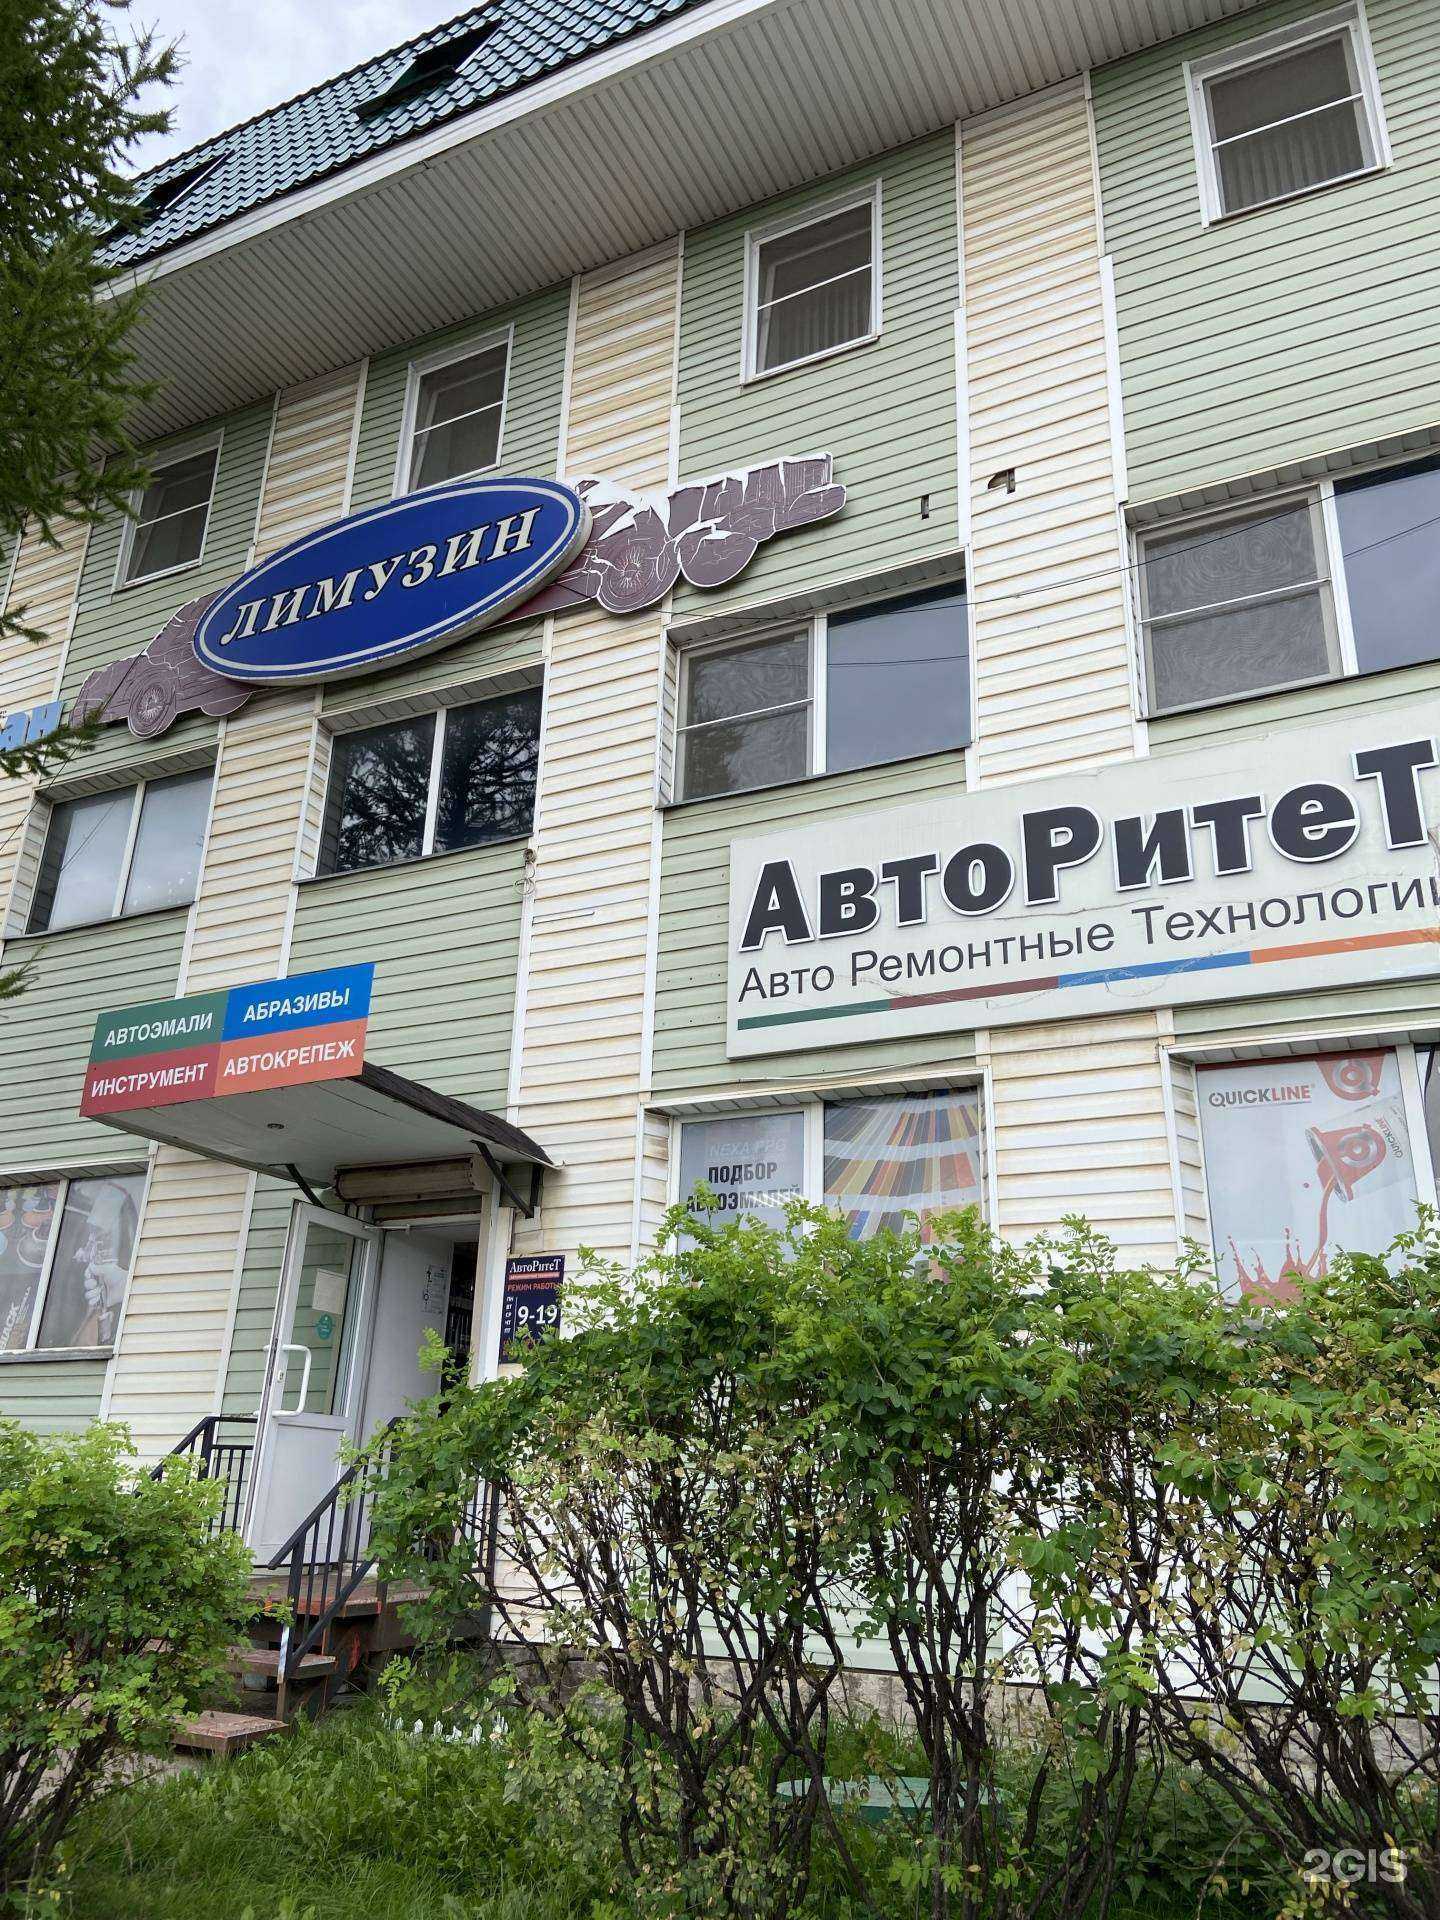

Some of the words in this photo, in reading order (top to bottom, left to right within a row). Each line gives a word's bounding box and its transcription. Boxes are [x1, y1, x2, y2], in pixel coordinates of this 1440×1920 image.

[219, 505, 543, 646] ЛИМУЗИН
[738, 965, 834, 1003] Авто
[851, 923, 1115, 987] Ремонтные
[243, 987, 350, 1023] АБРАЗИВЫ
[104, 1012, 213, 1047] АВТОЭМАЛИ
[223, 1038, 356, 1077] АВТОКРЕПЕЖ
[91, 1062, 208, 1098] ИНСТРУМЕНТ
[1208, 1084, 1311, 1107] QUICKLINE
[708, 1162, 778, 1185] ПОДБОР
[517, 1304, 558, 1325] 9-19
